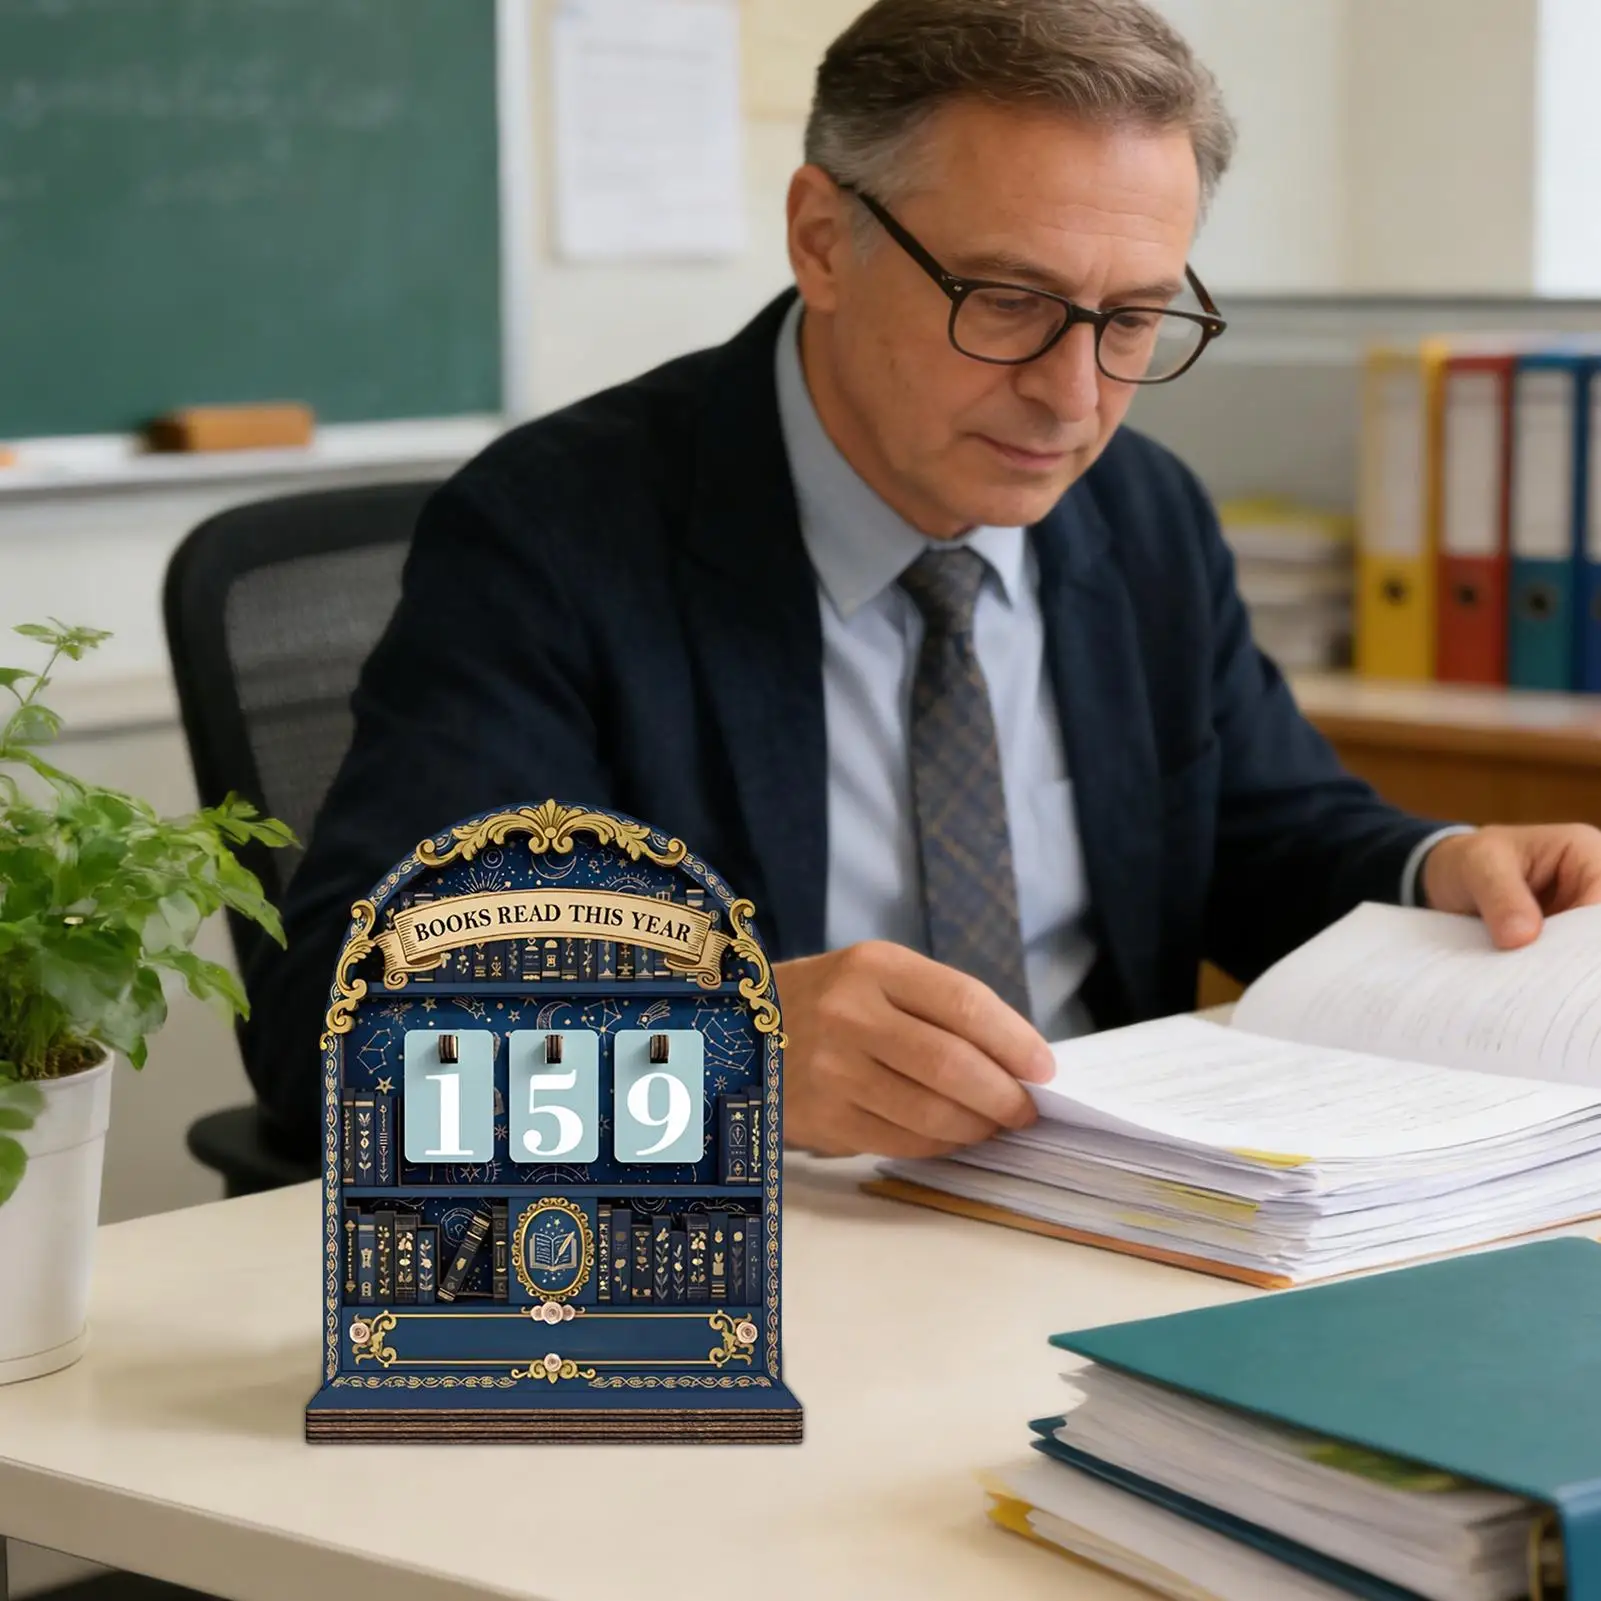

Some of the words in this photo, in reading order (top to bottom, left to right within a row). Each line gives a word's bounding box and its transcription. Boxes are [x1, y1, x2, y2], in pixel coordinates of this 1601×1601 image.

[414, 908, 491, 942] BOOKS
[497, 904, 561, 925] READ
[568, 904, 623, 926] THIS
[631, 911, 692, 943] YEAR
